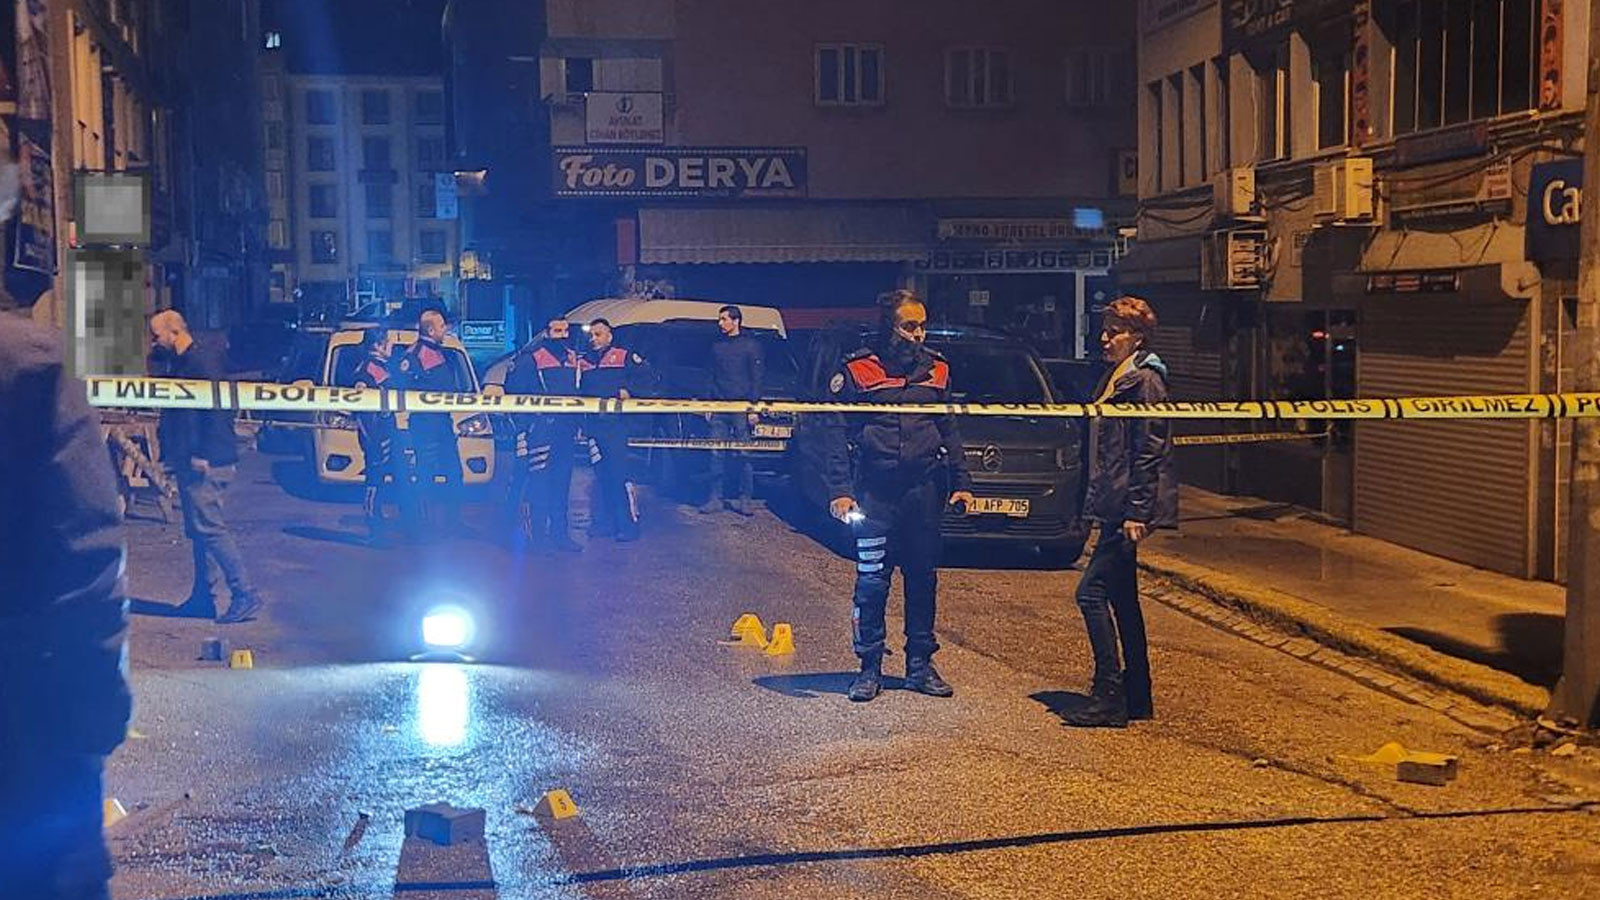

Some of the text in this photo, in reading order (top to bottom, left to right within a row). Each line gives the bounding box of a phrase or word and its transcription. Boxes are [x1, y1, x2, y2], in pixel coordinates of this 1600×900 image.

[559, 155, 795, 189] Foto DERYA
[1543, 180, 1583, 225] Ca
[984, 500, 1003, 512] AFP
[1009, 501, 1028, 512] 705
